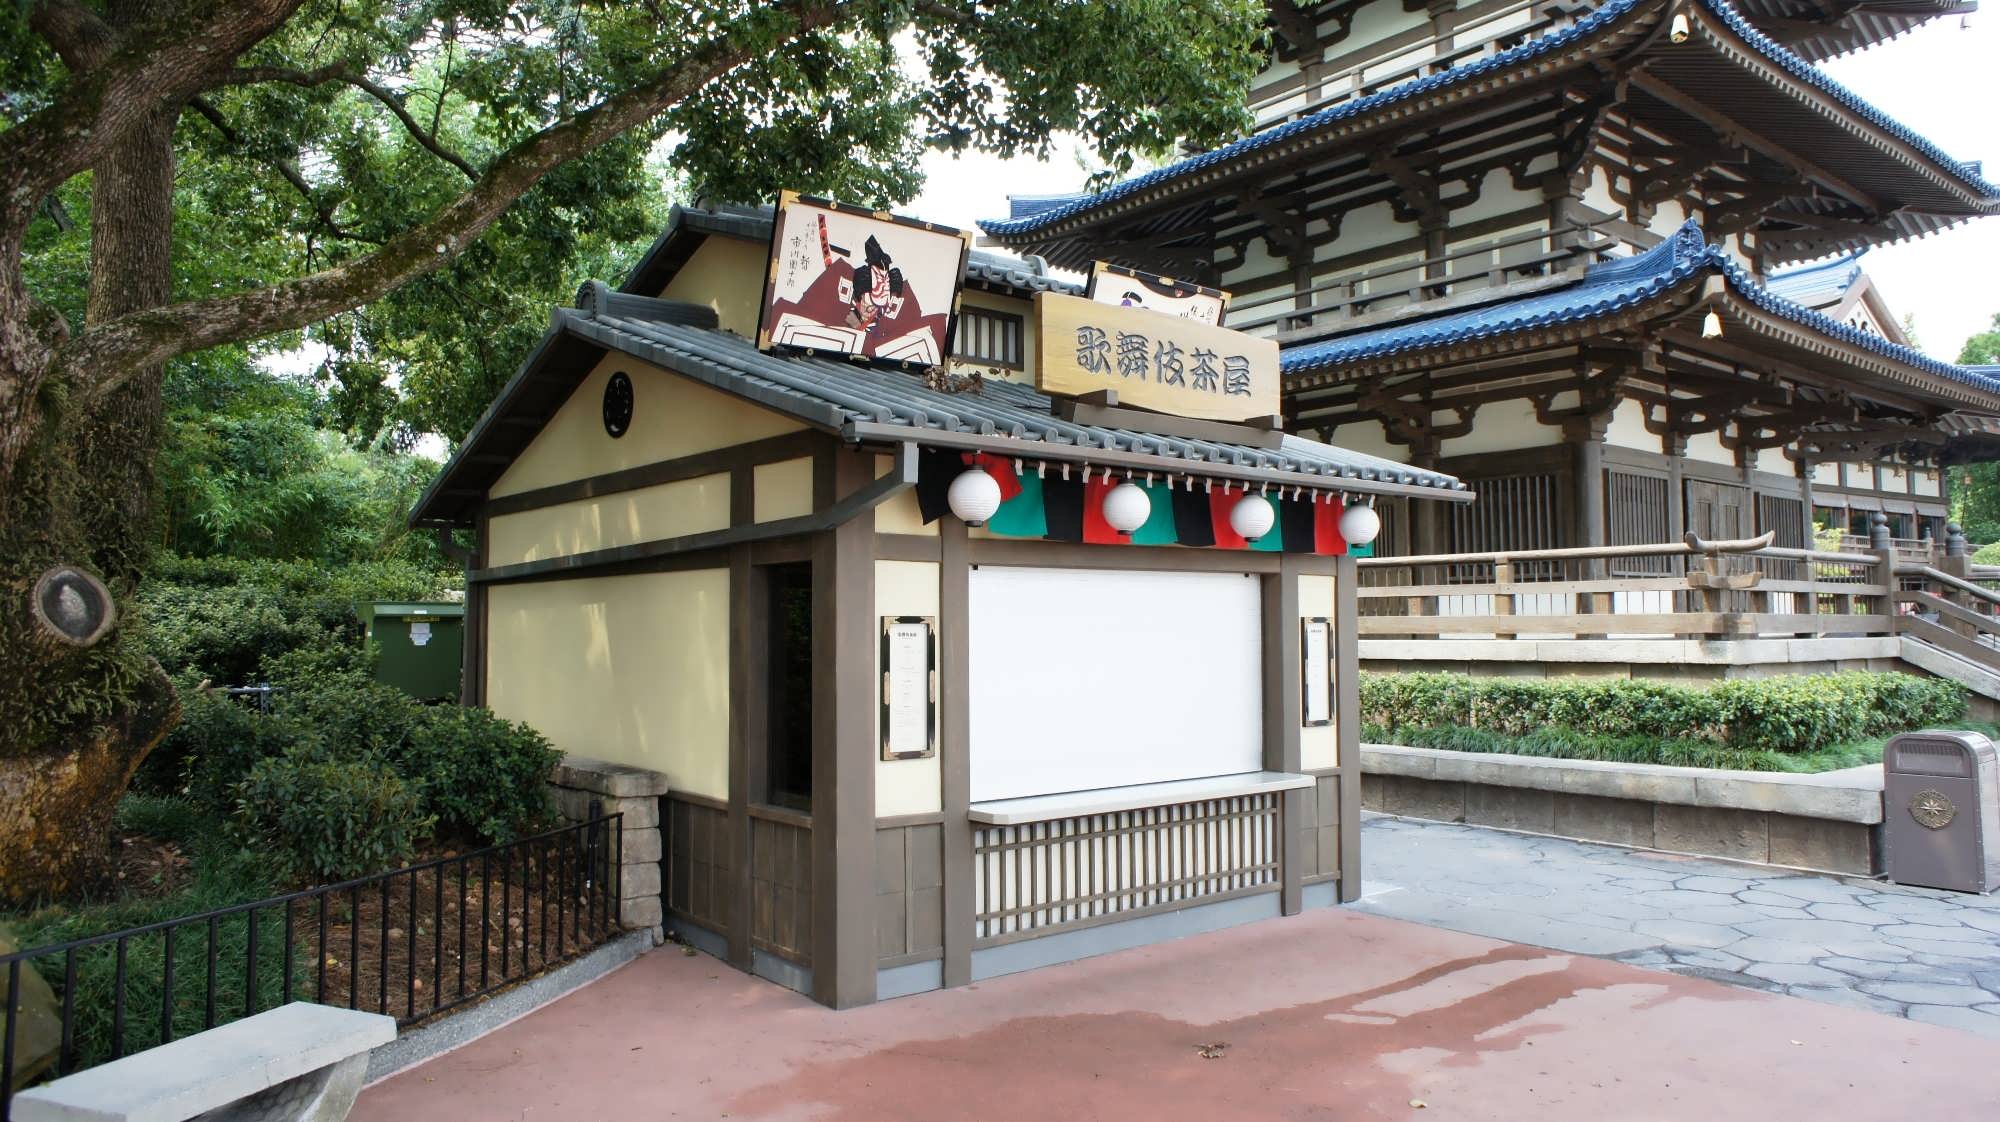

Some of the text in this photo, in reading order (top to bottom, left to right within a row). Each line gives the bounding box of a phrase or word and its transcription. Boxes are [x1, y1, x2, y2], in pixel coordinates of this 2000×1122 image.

[1076, 325, 1252, 398] 歌舞伎茶屋
